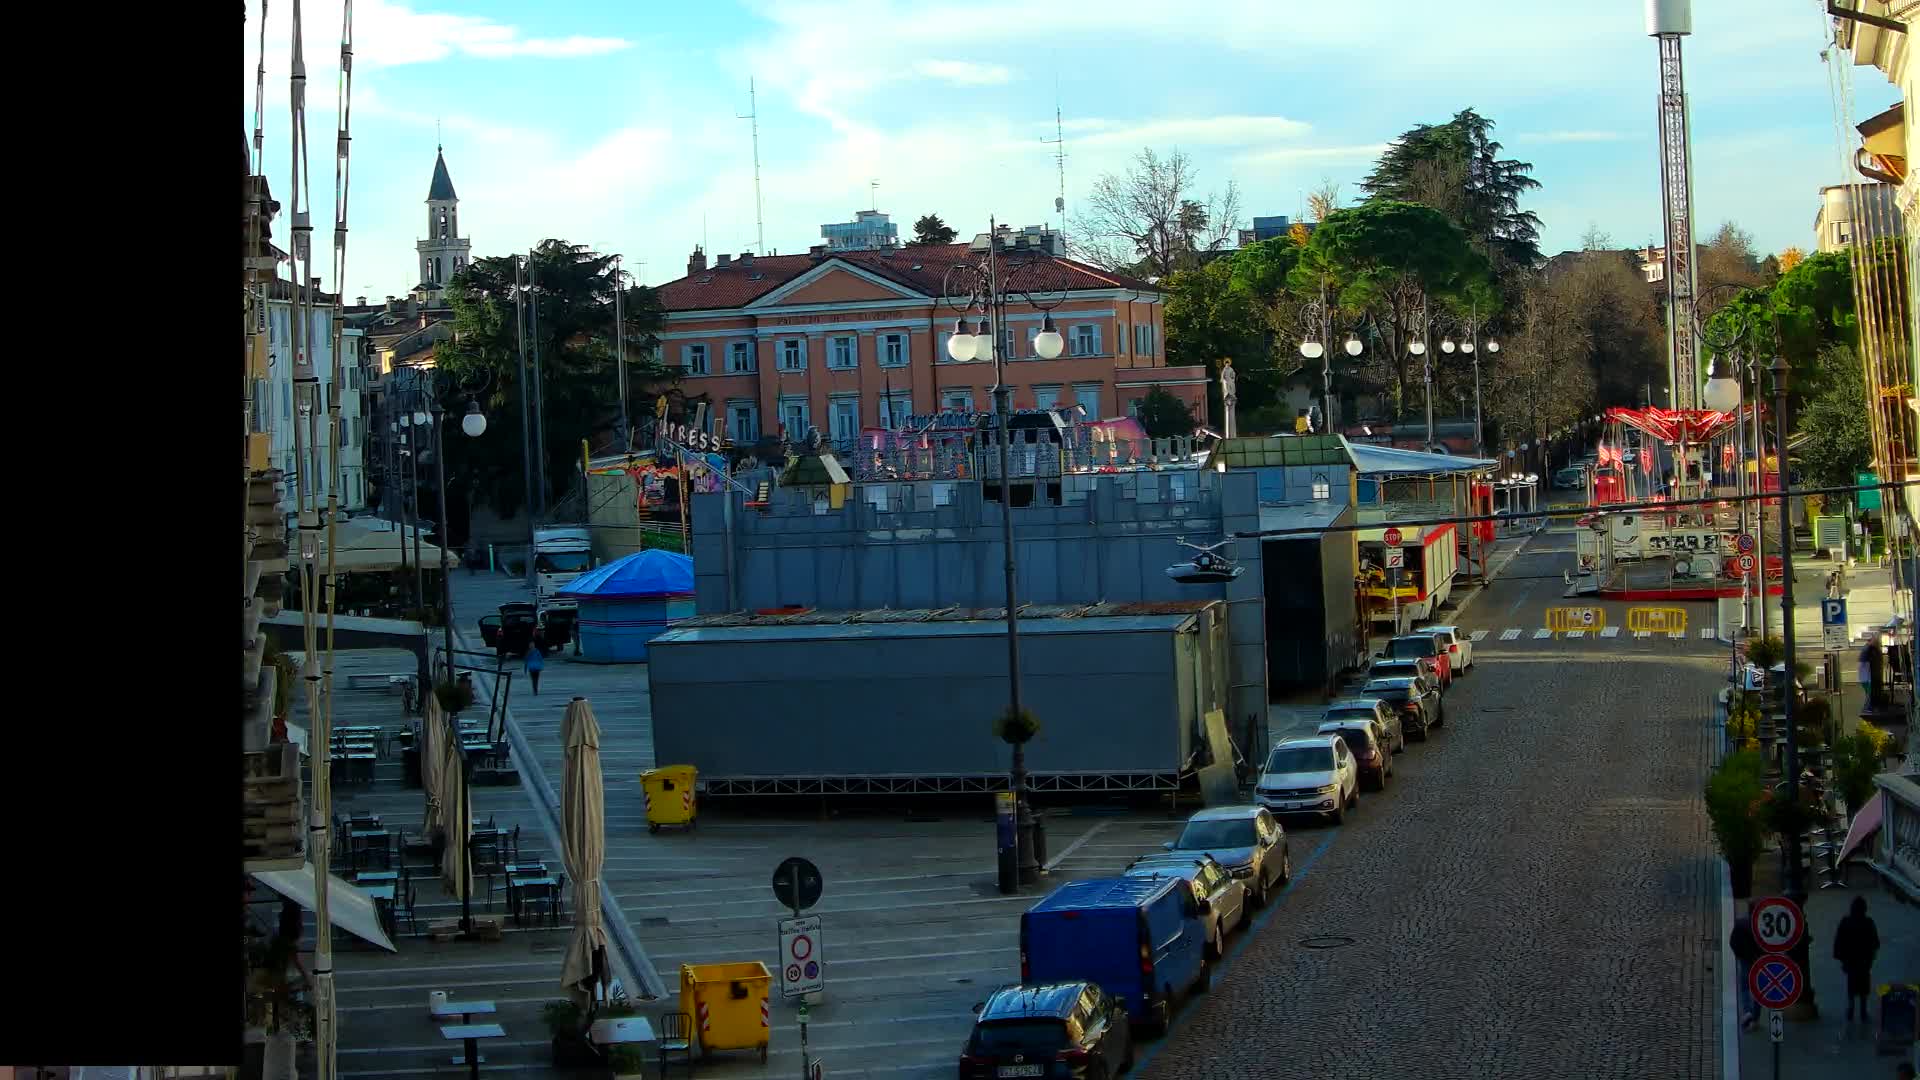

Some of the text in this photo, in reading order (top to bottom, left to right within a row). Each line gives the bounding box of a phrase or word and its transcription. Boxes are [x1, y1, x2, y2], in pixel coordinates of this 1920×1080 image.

[1385, 533, 1401, 542] STOP
[1741, 558, 1752, 567] 20
[1826, 602, 1842, 622] P
[1761, 912, 1792, 938] 30
[790, 969, 798, 979] 20
